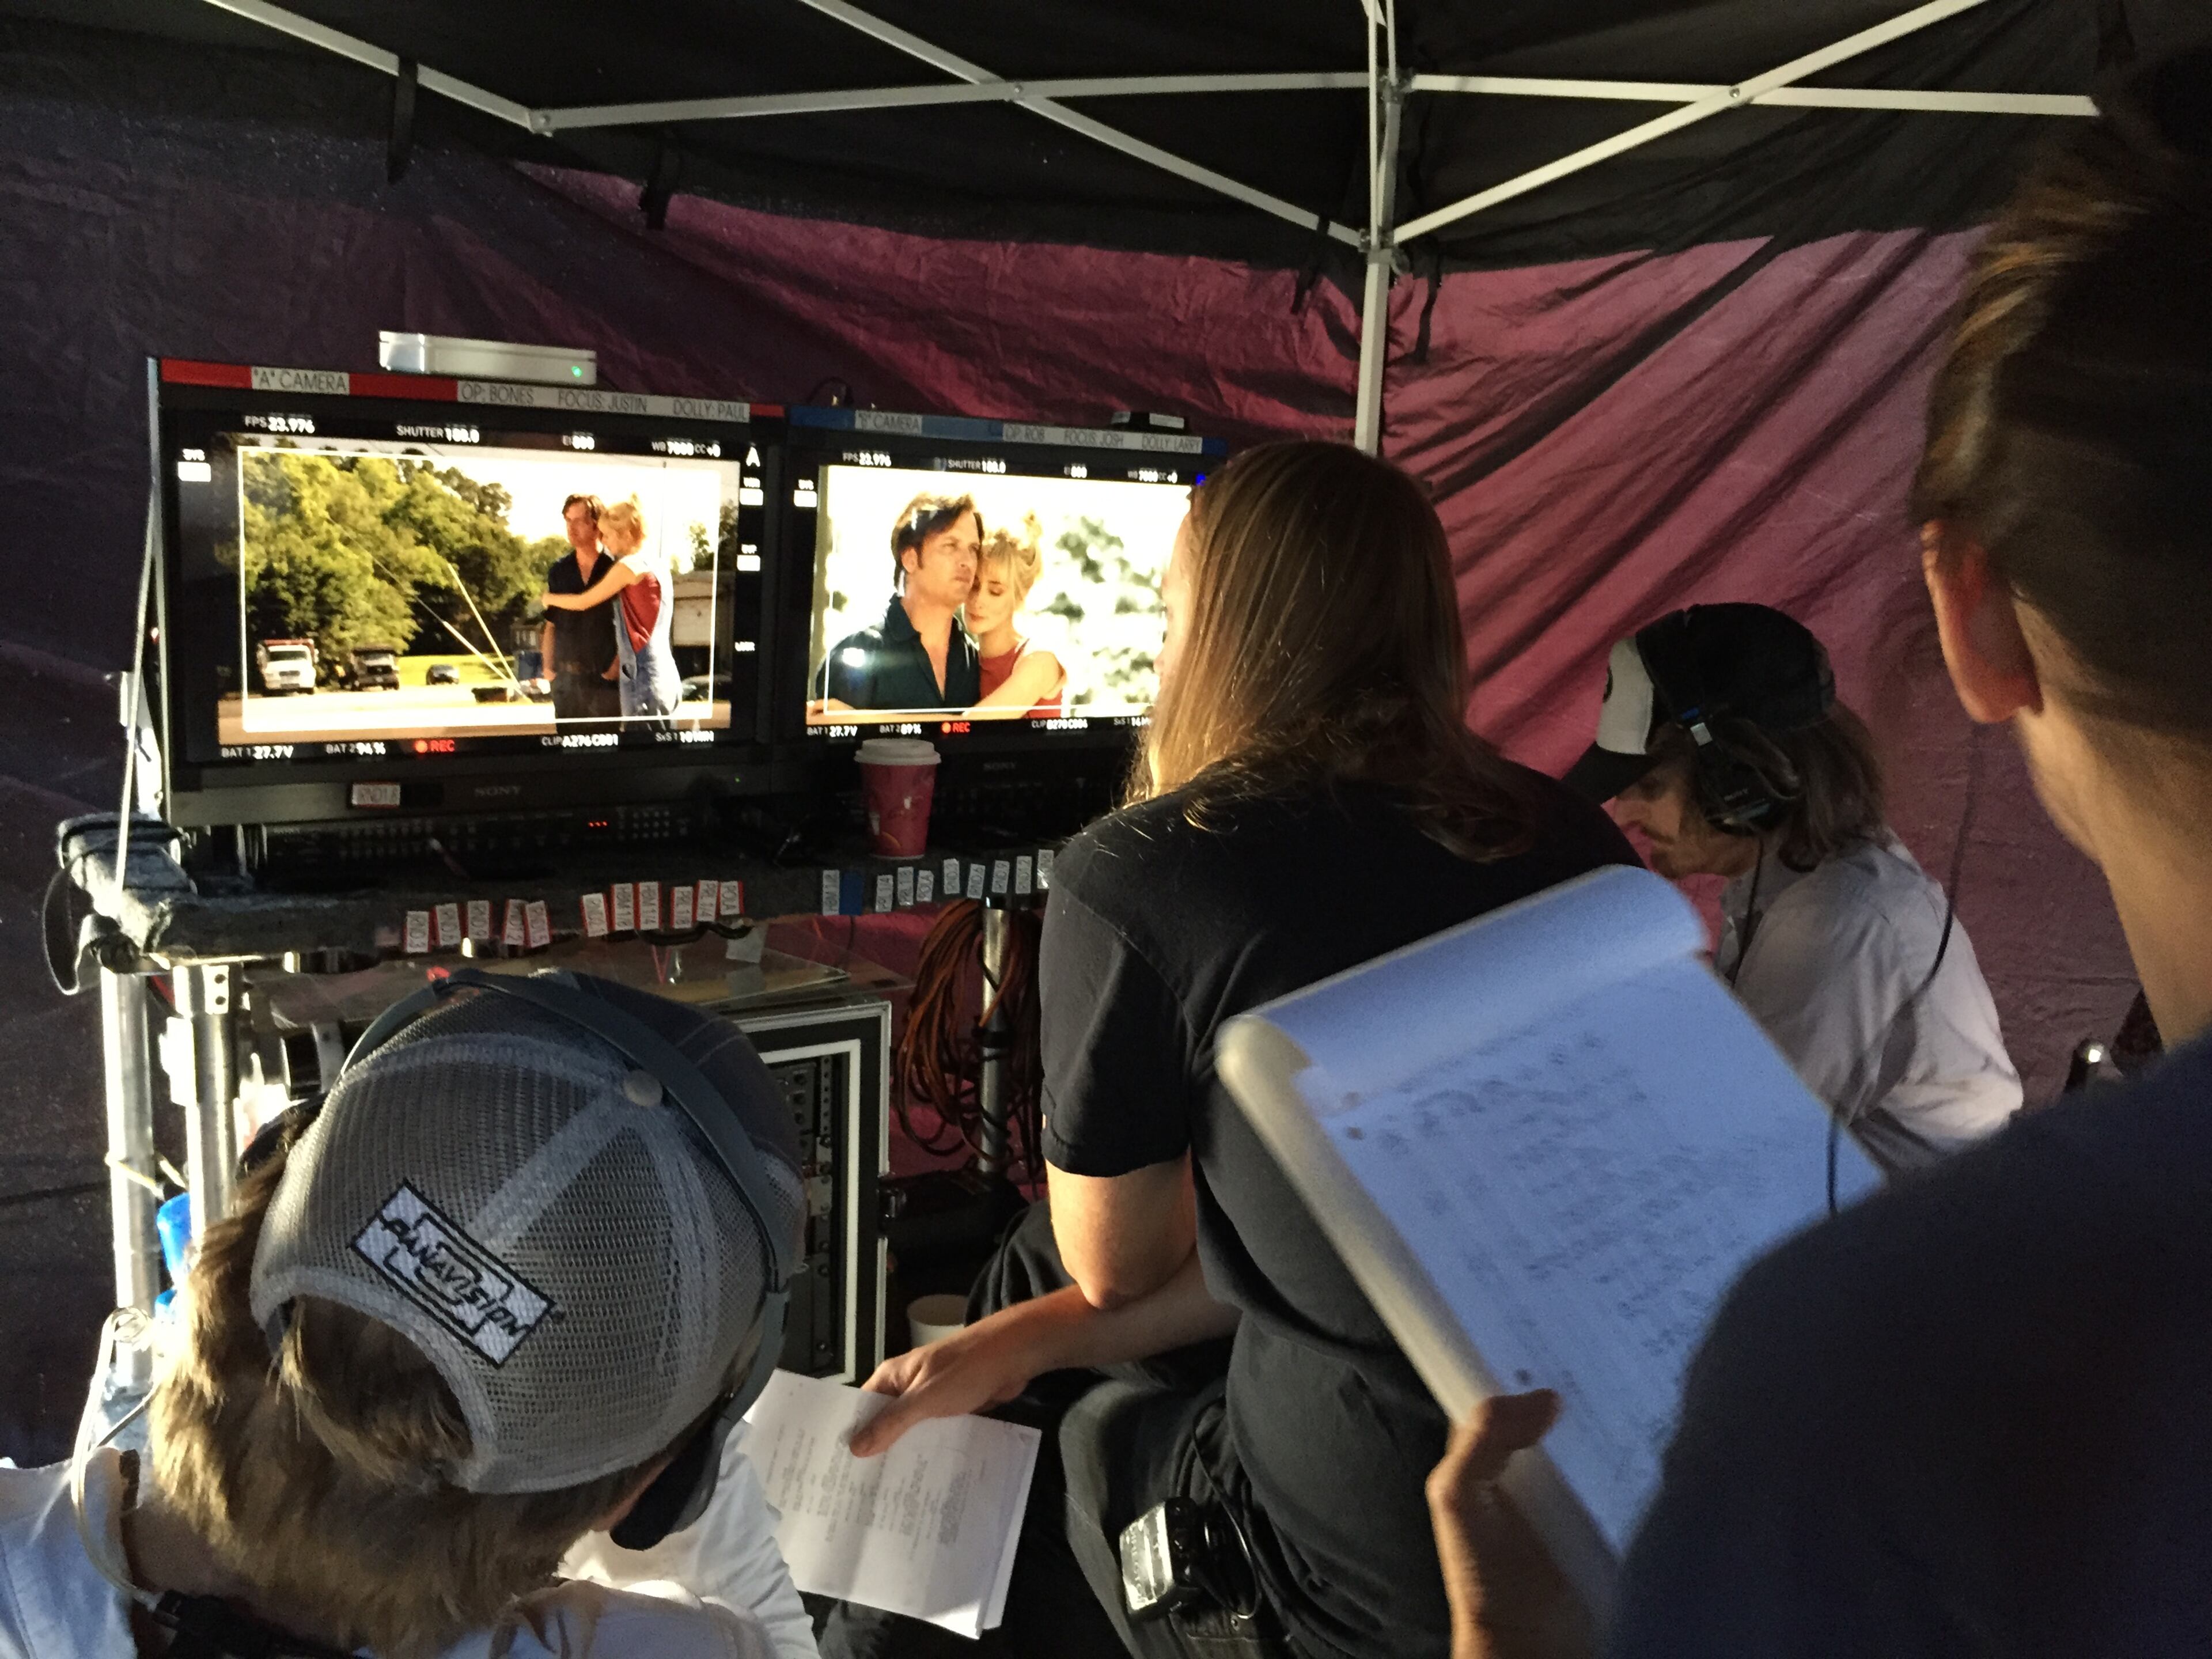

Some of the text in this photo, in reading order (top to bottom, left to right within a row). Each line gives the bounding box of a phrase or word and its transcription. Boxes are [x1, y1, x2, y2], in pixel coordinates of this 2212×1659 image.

[279, 370, 347, 392] CAMERA
[490, 385, 535, 405] BONES
[245, 415, 316, 433] FPS 23.976
[873, 414, 919, 432] CAMERA
[396, 425, 444, 438] SHUTTER
[745, 445, 760, 468] A
[843, 452, 892, 467] FPS 23.976
[948, 459, 981, 470] SHUTTER
[880, 725, 895, 734] BAT
[952, 722, 971, 733] REC
[1032, 719, 1047, 729] CLIP
[806, 726, 823, 736] BAT
[830, 725, 858, 737] 27.7V
[430, 740, 456, 752] REC
[541, 736, 563, 747] CLIP
[222, 747, 243, 758] BAT
[252, 745, 294, 760] 27.7V
[326, 743, 346, 754] BAT
[983, 761, 1017, 772] SONY
[474, 785, 522, 797] SONY
[381, 1215, 527, 1338] PANAVISION
